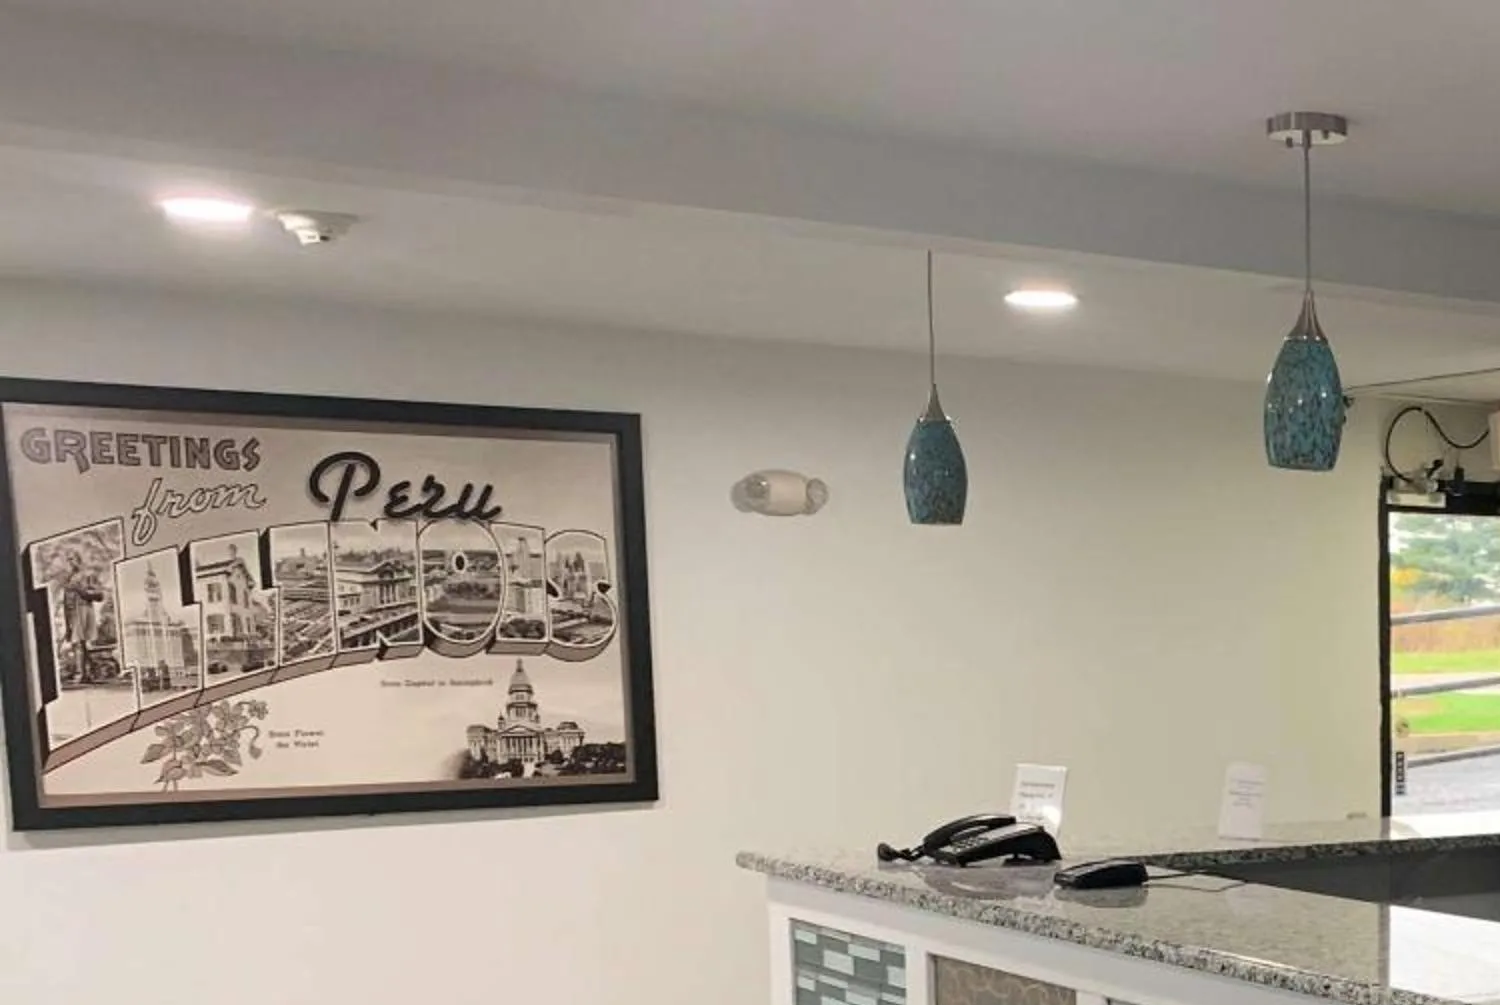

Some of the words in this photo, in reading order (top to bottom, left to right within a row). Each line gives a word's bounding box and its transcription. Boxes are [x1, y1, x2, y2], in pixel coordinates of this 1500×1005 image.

[20, 427, 261, 474] GREETINGS
[131, 477, 267, 546] from
[309, 451, 502, 522] Peru
[21, 517, 618, 774] ILLINOIS
